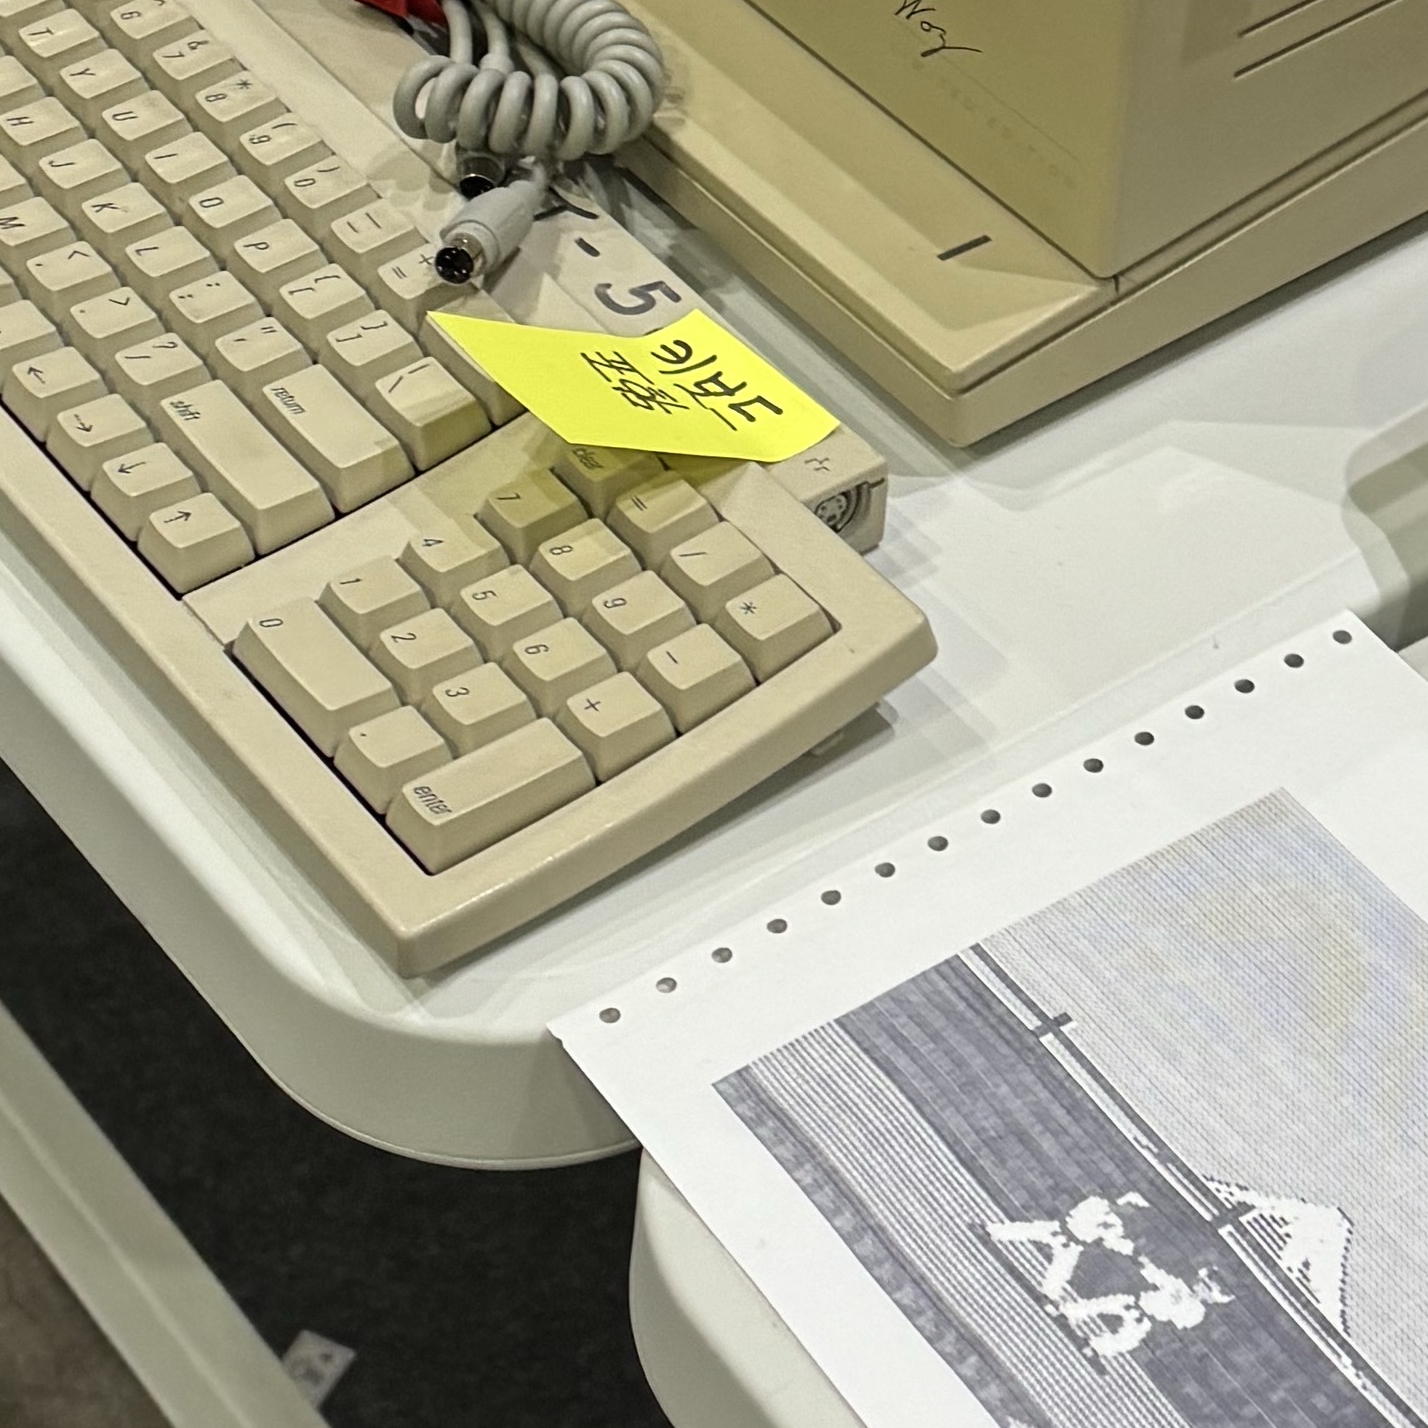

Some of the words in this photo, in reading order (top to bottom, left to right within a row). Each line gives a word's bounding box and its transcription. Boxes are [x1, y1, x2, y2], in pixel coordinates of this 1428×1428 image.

[120, 10, 143, 21] 6
[27, 27, 55, 36] T
[162, 50, 185, 59] 7
[69, 67, 96, 77] Y
[204, 92, 228, 103] 8
[6, 116, 34, 127] H
[111, 110, 138, 122] U
[248, 134, 272, 145] 9
[48, 160, 76, 168] J
[90, 202, 117, 213] K
[134, 246, 160, 256] L
[243, 241, 270, 251] P
[580, 350, 690, 415] 포함
[650, 339, 785, 432] 키보드
[270, 386, 306, 415] return
[169, 400, 202, 421] shift
[496, 492, 522, 501] 7
[422, 538, 445, 547] 4
[548, 544, 574, 556] 8
[471, 589, 497, 601] 5
[603, 597, 627, 610] 9
[390, 632, 417, 643] 2
[524, 643, 550, 655] 6
[444, 686, 470, 698] 3
[413, 785, 453, 815] enter
